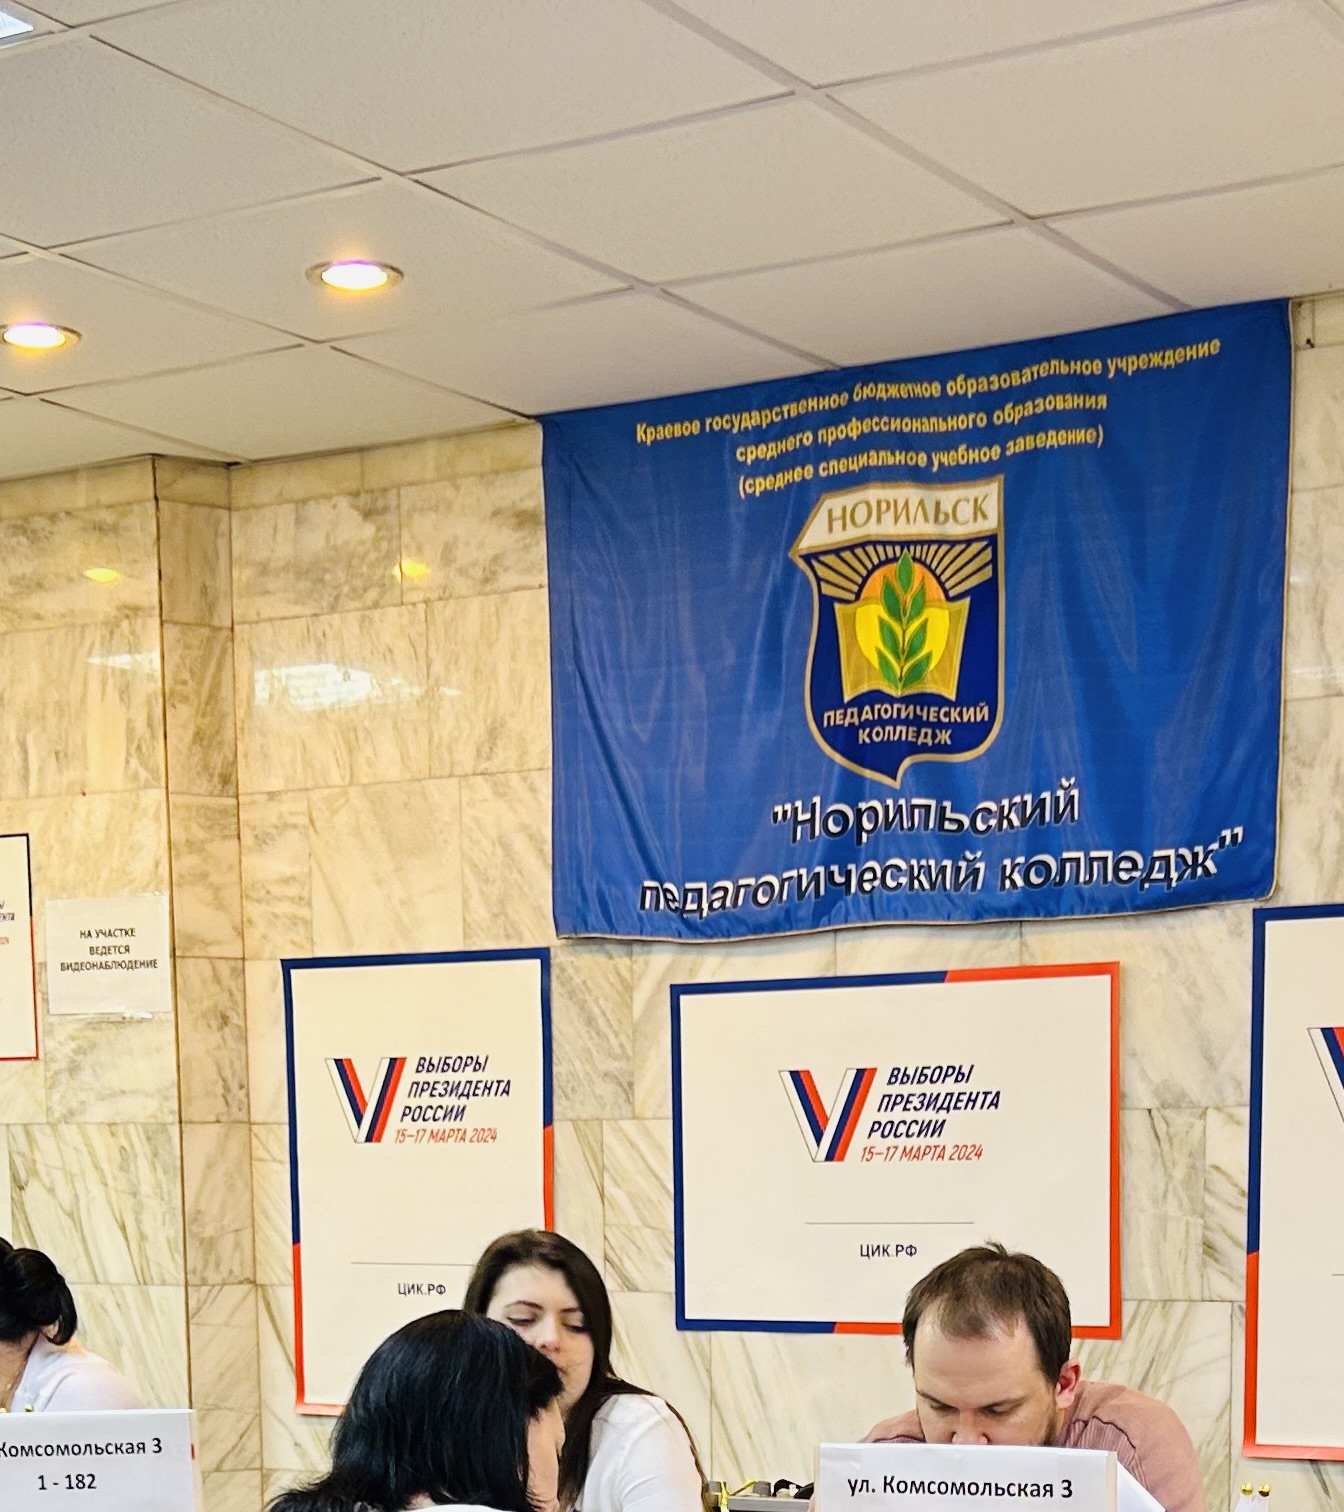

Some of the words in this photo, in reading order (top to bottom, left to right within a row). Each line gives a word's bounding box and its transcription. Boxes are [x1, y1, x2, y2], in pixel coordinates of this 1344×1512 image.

[636, 418, 701, 447] Краевое
[705, 391, 850, 434] государственное
[853, 381, 941, 402] бюджетное
[947, 357, 1102, 398] образовательное
[1108, 337, 1221, 378] учреждение
[736, 431, 813, 465] среднего
[818, 411, 987, 447] профессионального
[993, 393, 1107, 424] образования
[739, 466, 814, 499] (среднее
[819, 450, 927, 478] специальное
[932, 441, 1001, 472] учебное
[1006, 424, 1104, 455] заведение)
[827, 493, 990, 535] НОРИЛЬСК
[823, 701, 990, 728] ПЕДАГОГИЧЕСКИЙ
[858, 725, 952, 746] КОЛЛЕДЖ
[639, 851, 986, 920] педагогический
[80, 929, 92, 939] НА
[95, 927, 136, 939] УЧАСТКЕ
[89, 945, 130, 956] ВЕДЕТСЯ
[60, 958, 158, 972] ВИДЕОНАБЛЮДЕНИЕ
[415, 1055, 489, 1074] ВЫБОРЫ
[887, 1064, 975, 1086] ВЫБОРЫ
[408, 1079, 511, 1099] ПРЕЗИДЕНТА
[877, 1090, 1001, 1114] ПРЕЗИДЕНТА
[400, 1105, 467, 1123] РОССИИ
[430, 1128, 467, 1144] МАРТА
[469, 1127, 497, 1144] 2024
[867, 1119, 946, 1140] РОССИИ
[899, 1145, 946, 1162] МАРТА
[948, 1143, 984, 1162] 2024
[860, 1242, 918, 1259] ЦИК.РФ
[397, 1282, 446, 1297] ЦИК.РФ
[152, 1437, 163, 1454] 3
[37, 1474, 47, 1490] 1
[65, 1473, 97, 1490] 182
[847, 1478, 876, 1498] ул.
[883, 1476, 1054, 1498] Комсомольская
[1060, 1479, 1073, 1498] 3
